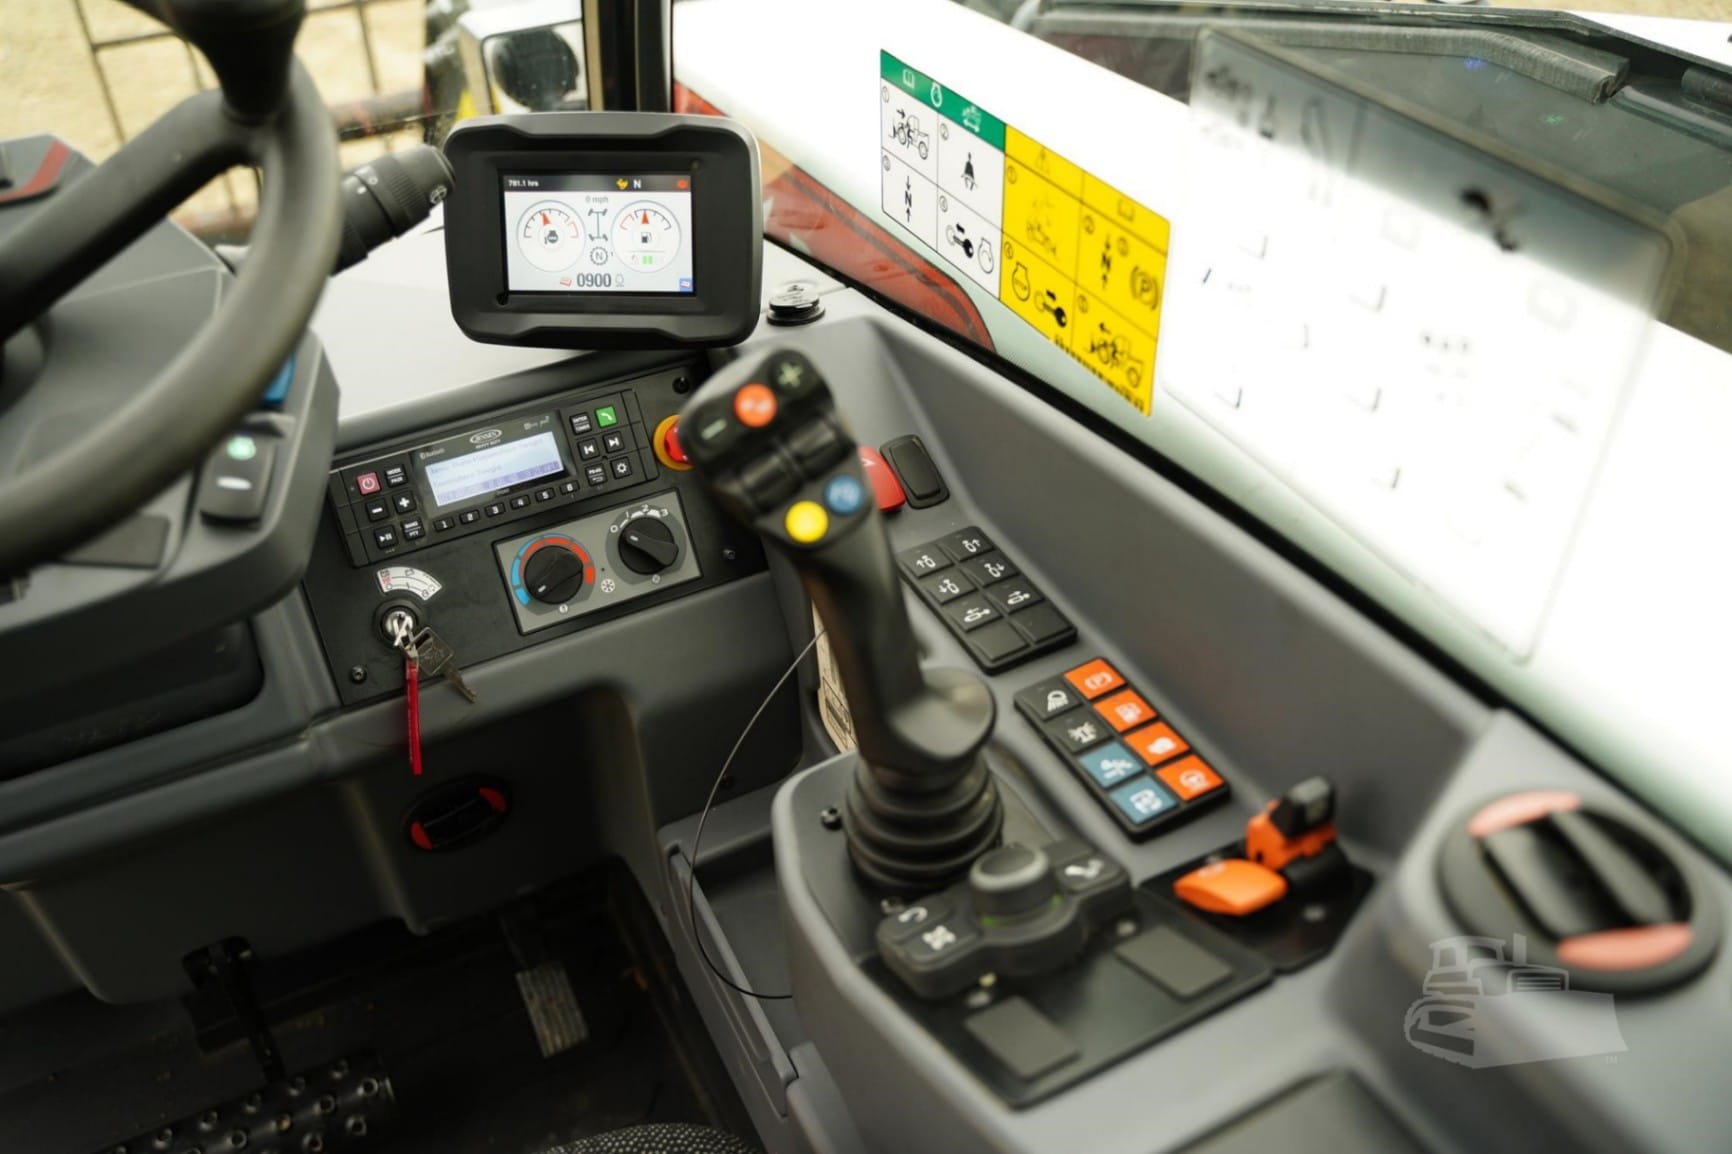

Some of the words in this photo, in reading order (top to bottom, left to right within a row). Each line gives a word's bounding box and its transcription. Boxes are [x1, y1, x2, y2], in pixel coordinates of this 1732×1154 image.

[634, 180, 642, 188] N
[592, 196, 609, 204] mph
[905, 190, 912, 208] N
[596, 252, 603, 260] N
[1102, 254, 1110, 270] N
[577, 273, 611, 287] 0900
[1140, 277, 1150, 296] P
[661, 508, 668, 516] 3
